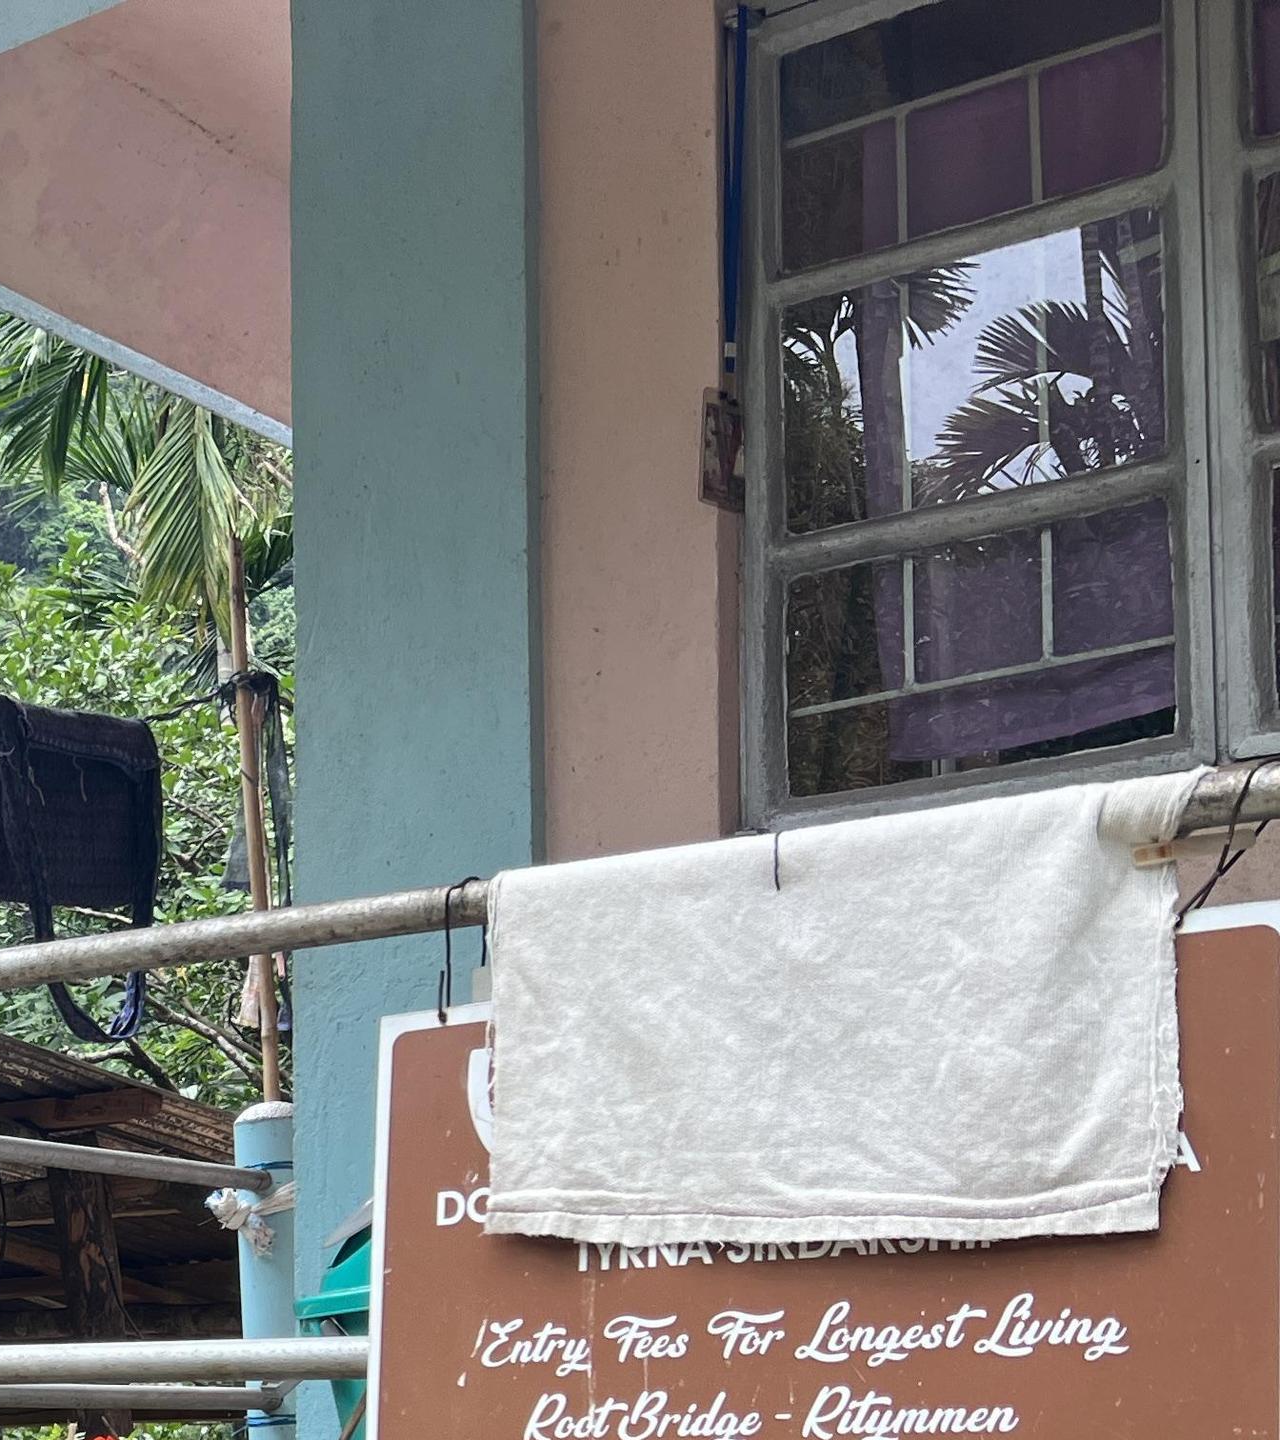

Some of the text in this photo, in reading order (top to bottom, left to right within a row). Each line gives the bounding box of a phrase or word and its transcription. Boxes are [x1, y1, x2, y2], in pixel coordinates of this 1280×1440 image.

[480, 1292, 1130, 1377] Entry Fees For Longest Living
